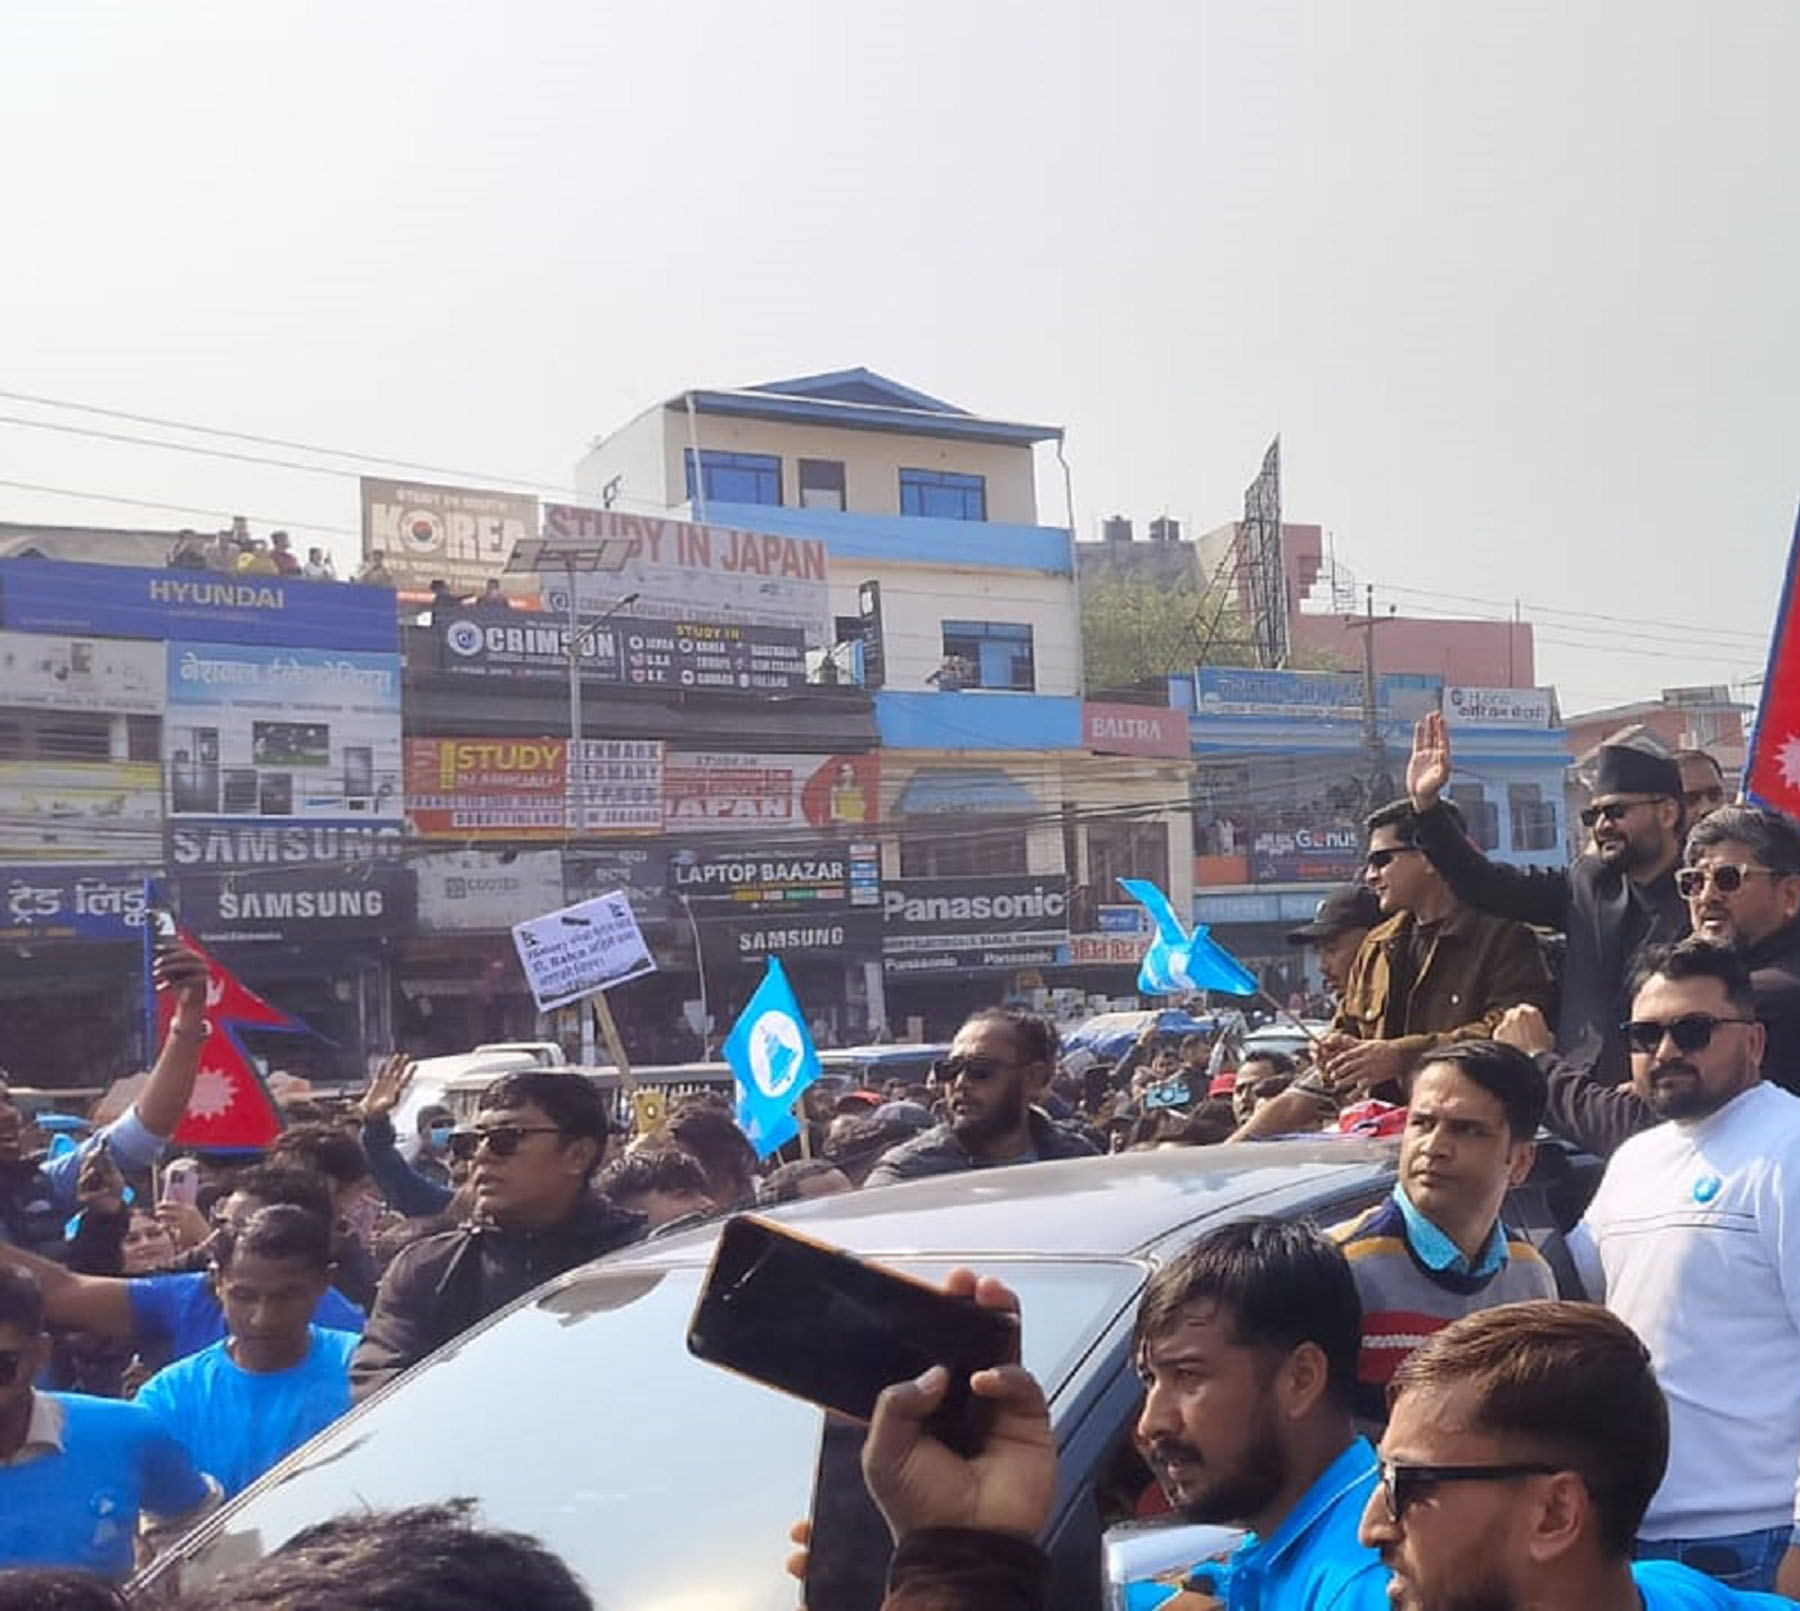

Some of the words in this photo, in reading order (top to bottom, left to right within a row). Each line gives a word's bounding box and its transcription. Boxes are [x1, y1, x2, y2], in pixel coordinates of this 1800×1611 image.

[550, 507, 665, 563] STUDY
[677, 522, 711, 567] IN
[721, 530, 826, 580] JAPAN
[149, 578, 284, 609] HYUNDAI
[675, 624, 720, 639] STUDY
[1091, 717, 1162, 740] BALTRA
[456, 745, 562, 770] STUDY
[173, 828, 403, 864] SAMSUNG
[676, 864, 757, 883] LAPTOP
[761, 862, 844, 881] BAAZAR
[219, 891, 384, 919] SAMSUNG
[883, 885, 1066, 922] Panasonic
[739, 926, 844, 951] SAMSUNG
[884, 954, 958, 971] Panasonic
[983, 950, 1052, 964] Panasonic
